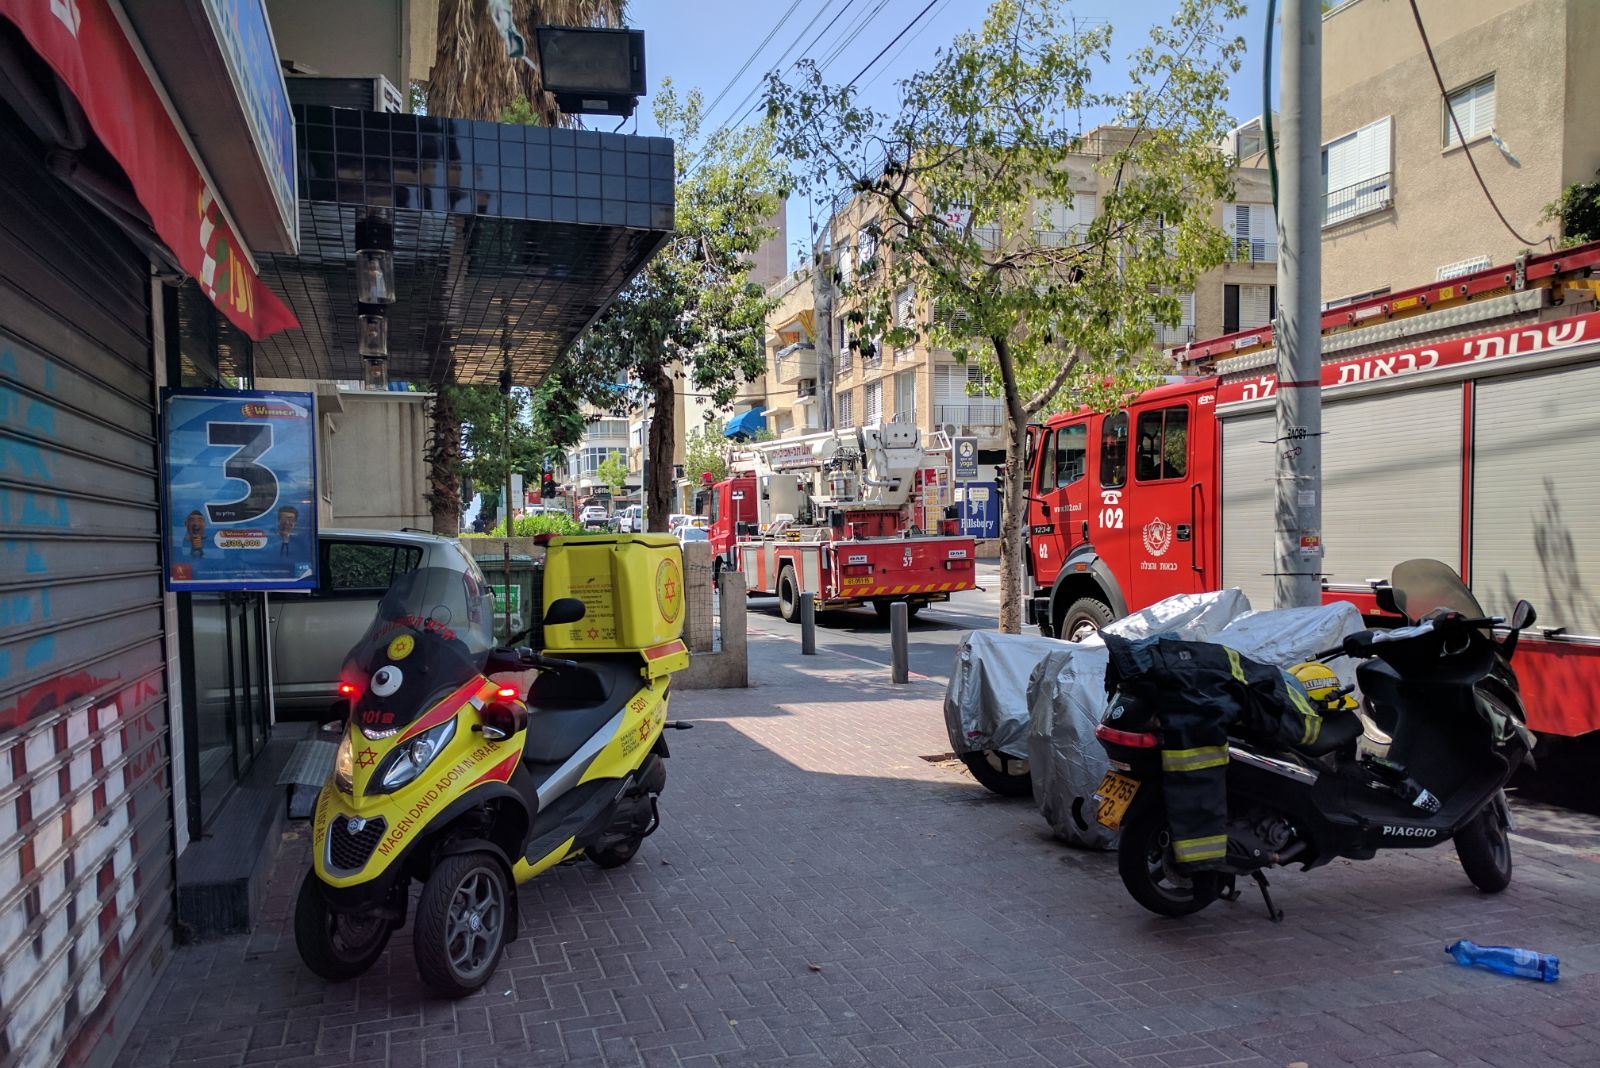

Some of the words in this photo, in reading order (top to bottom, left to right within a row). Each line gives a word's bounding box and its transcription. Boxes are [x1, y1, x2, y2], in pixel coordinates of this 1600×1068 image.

[1462, 320, 1587, 361] שרותי
[1337, 349, 1439, 385] כבאות
[253, 406, 296, 417] Winner
[204, 421, 280, 525] 3
[961, 518, 994, 530] Pllsbury
[1098, 508, 1124, 529] 102
[1039, 543, 1048, 559] 62
[902, 556, 913, 567] 37
[1140, 560, 1157, 571] והצלה
[1159, 562, 1178, 571] כבאות
[630, 697, 649, 714] 5201
[362, 710, 379, 724] 101
[378, 818, 414, 857] MAGEN
[409, 790, 439, 823] DAVID
[438, 766, 466, 795] ADOM
[463, 758, 475, 771] IN
[472, 741, 501, 765] ISRAEL
[1382, 825, 1437, 837] PIAGGIO
